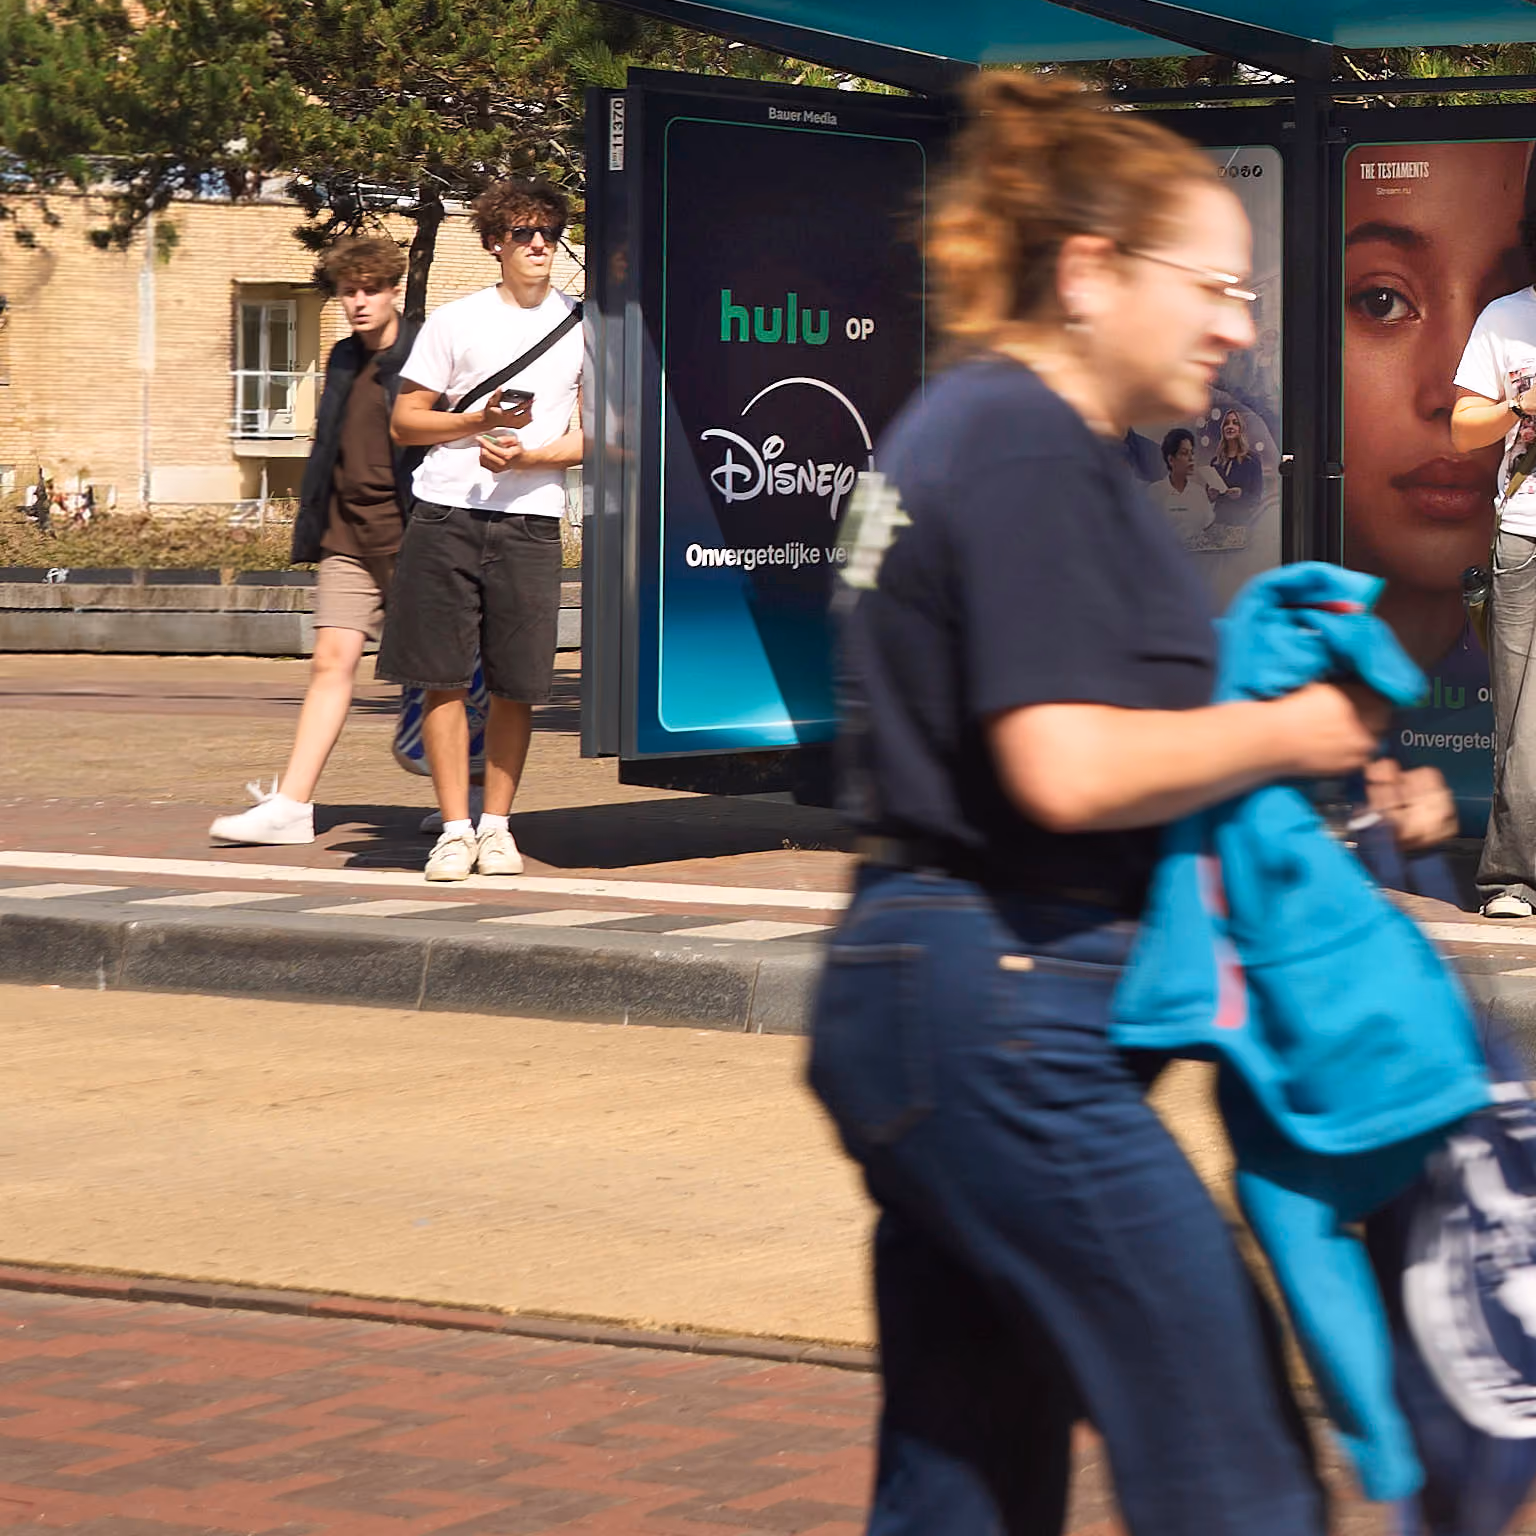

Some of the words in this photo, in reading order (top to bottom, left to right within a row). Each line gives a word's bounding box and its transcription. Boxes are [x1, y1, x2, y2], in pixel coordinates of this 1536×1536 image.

[613, 100, 624, 149] 11370
[768, 107, 802, 122] Bauer
[804, 110, 838, 125] Media
[1360, 163, 1376, 179] THE
[1377, 161, 1430, 179] TESTAMENTS
[720, 289, 829, 344] hulu
[845, 319, 874, 340] OP
[700, 429, 856, 521] Disney
[685, 543, 820, 571] Onvergetelijke
[1400, 728, 1497, 752] Onvergetel
